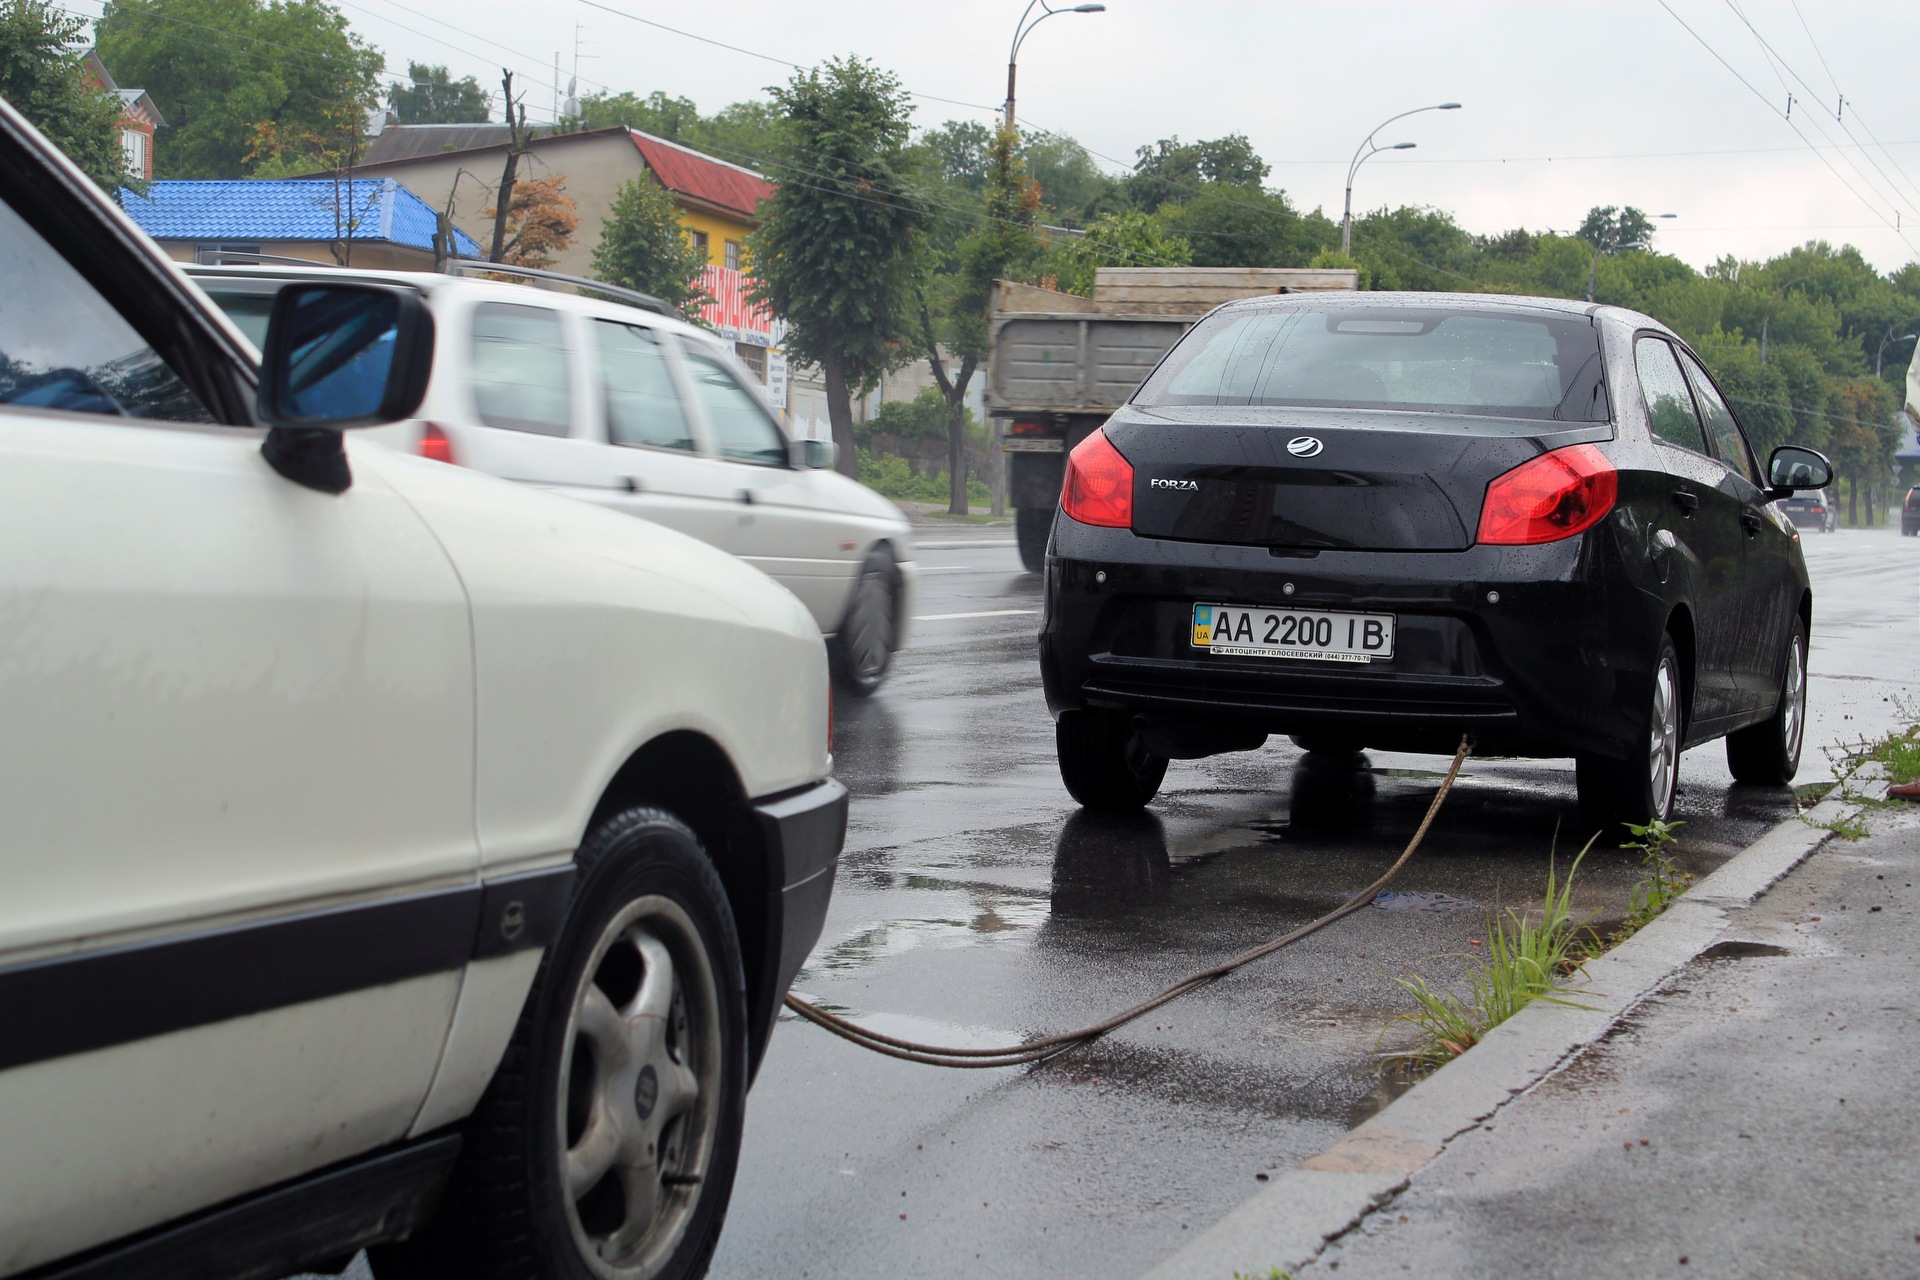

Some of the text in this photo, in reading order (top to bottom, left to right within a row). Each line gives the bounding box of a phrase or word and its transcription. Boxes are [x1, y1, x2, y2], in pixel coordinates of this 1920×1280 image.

[1150, 478, 1199, 491] FORZA
[1196, 611, 1384, 650] UA AA 2200 IB
[1224, 648, 1267, 656] АВТОЦЕНТР
[1267, 650, 1323, 659] ГОЛОСЕЕВСКИЙ
